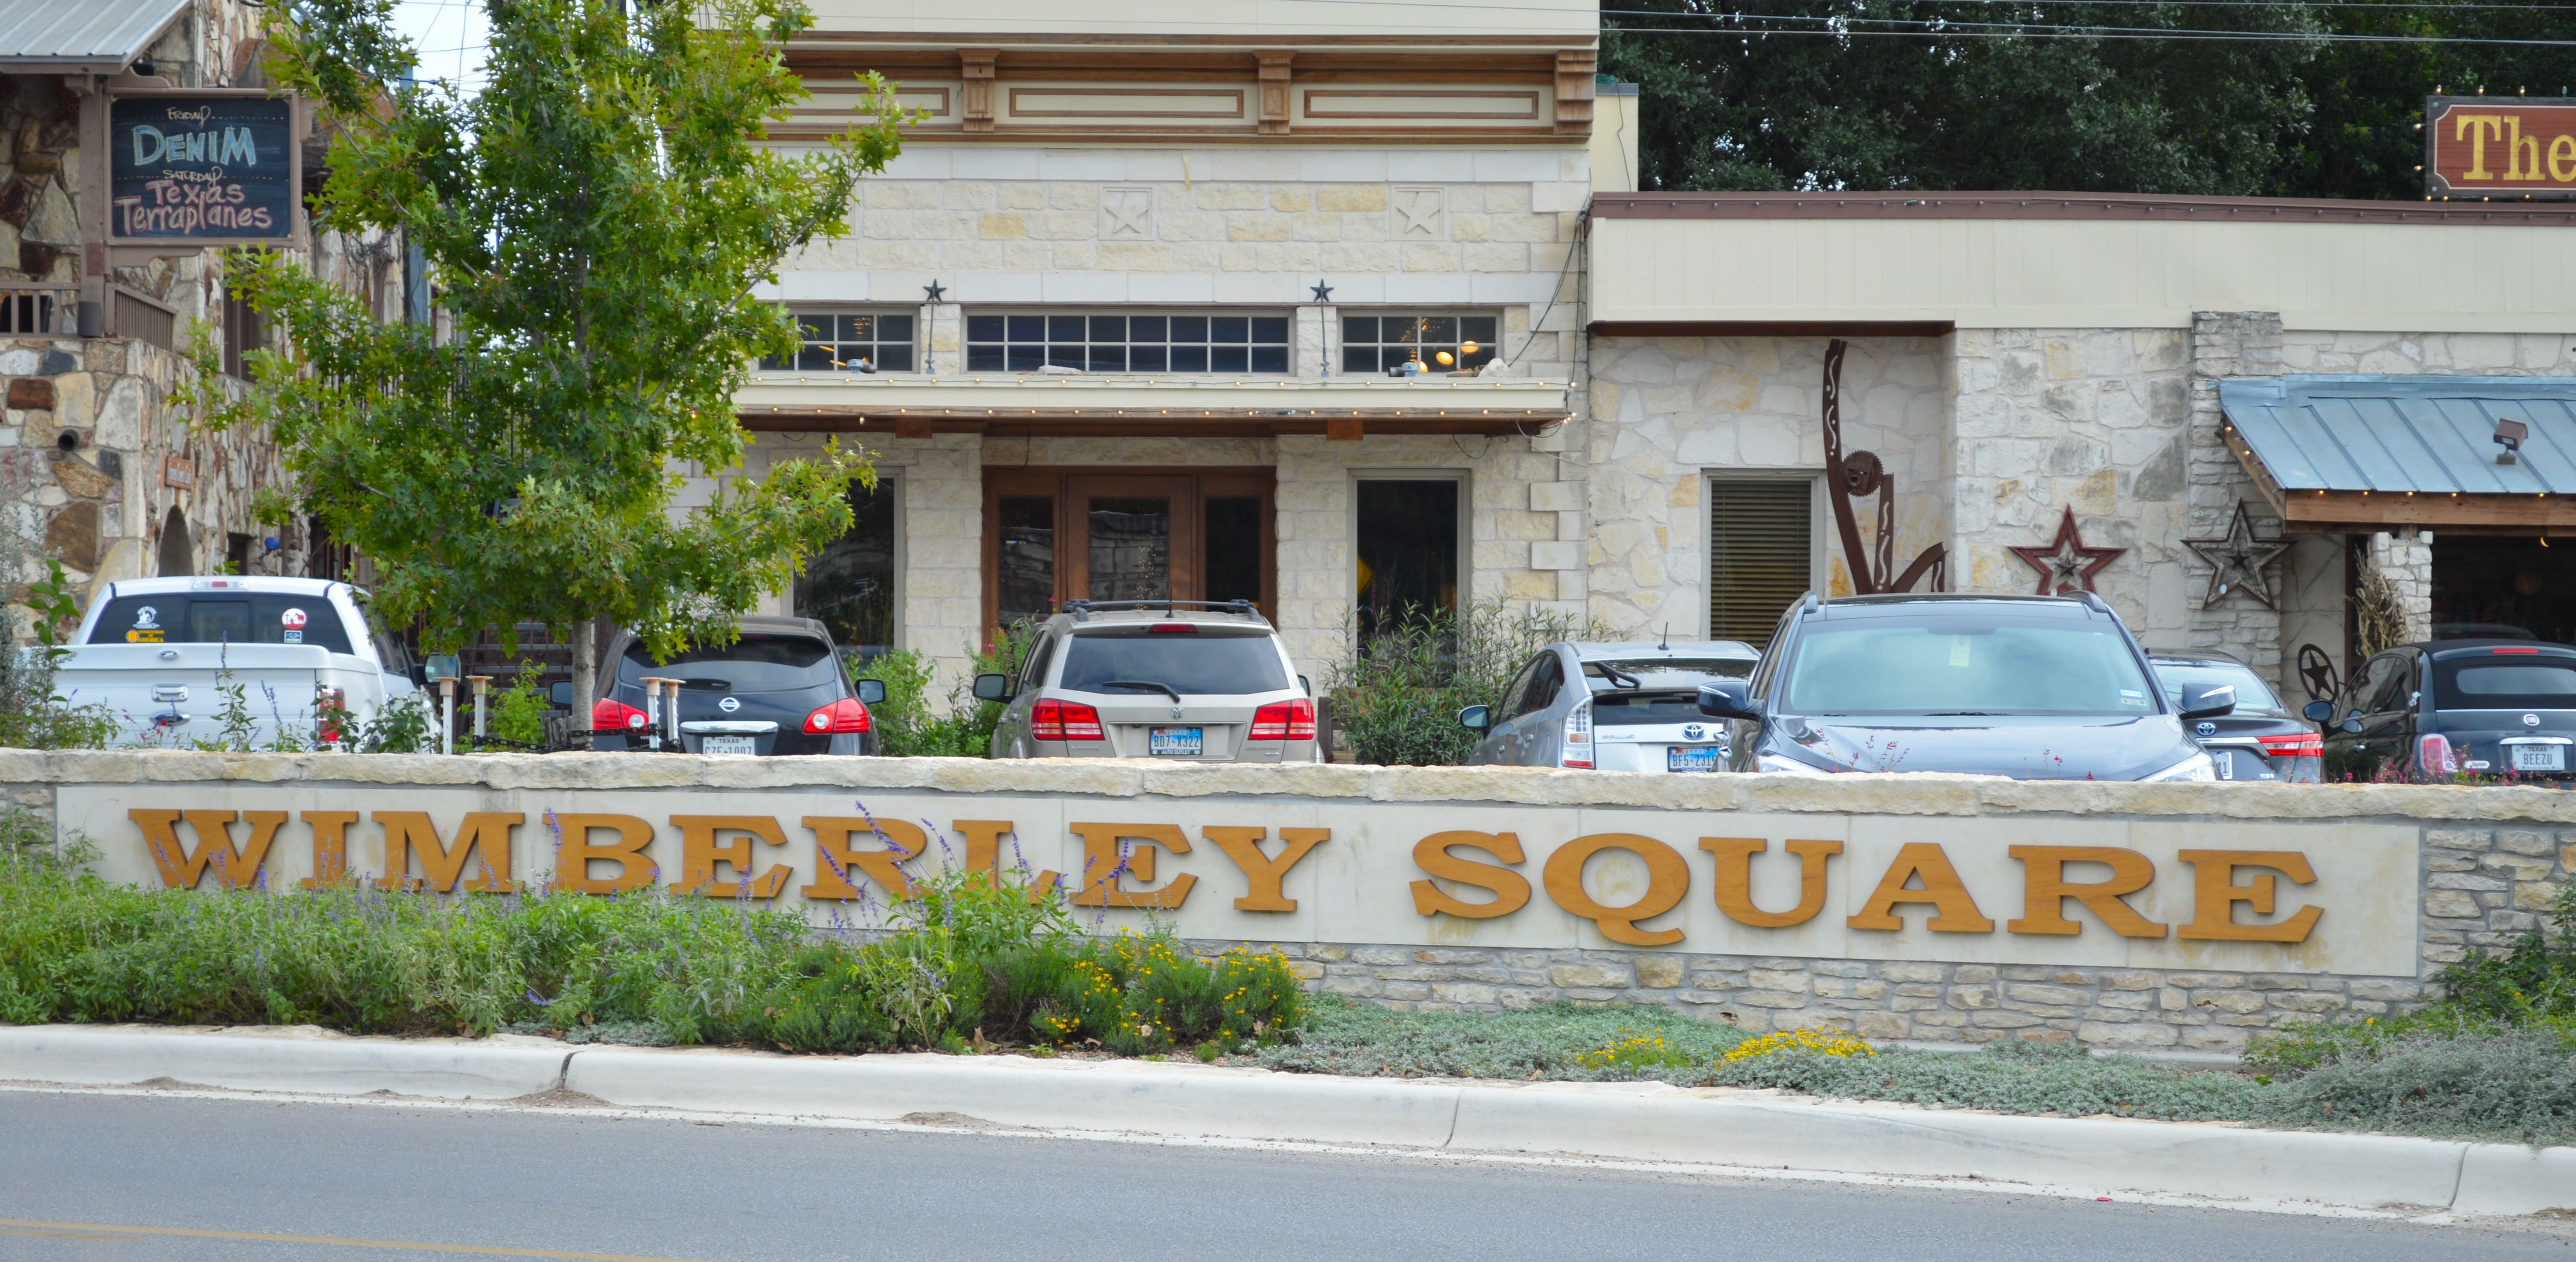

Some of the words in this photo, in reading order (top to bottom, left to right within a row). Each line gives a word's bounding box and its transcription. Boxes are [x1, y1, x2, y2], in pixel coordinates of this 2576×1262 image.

[166, 106, 211, 127] FRIDAY
[132, 125, 256, 167] DENIM
[2456, 115, 2576, 182] The
[145, 179, 245, 205] Texas
[163, 166, 222, 188] SATURDAY
[114, 191, 273, 235] Terraplanes
[2524, 753, 2552, 765] BEEZU
[128, 808, 1331, 912] WIMBERLEY
[1409, 830, 2325, 946] SQUARE
